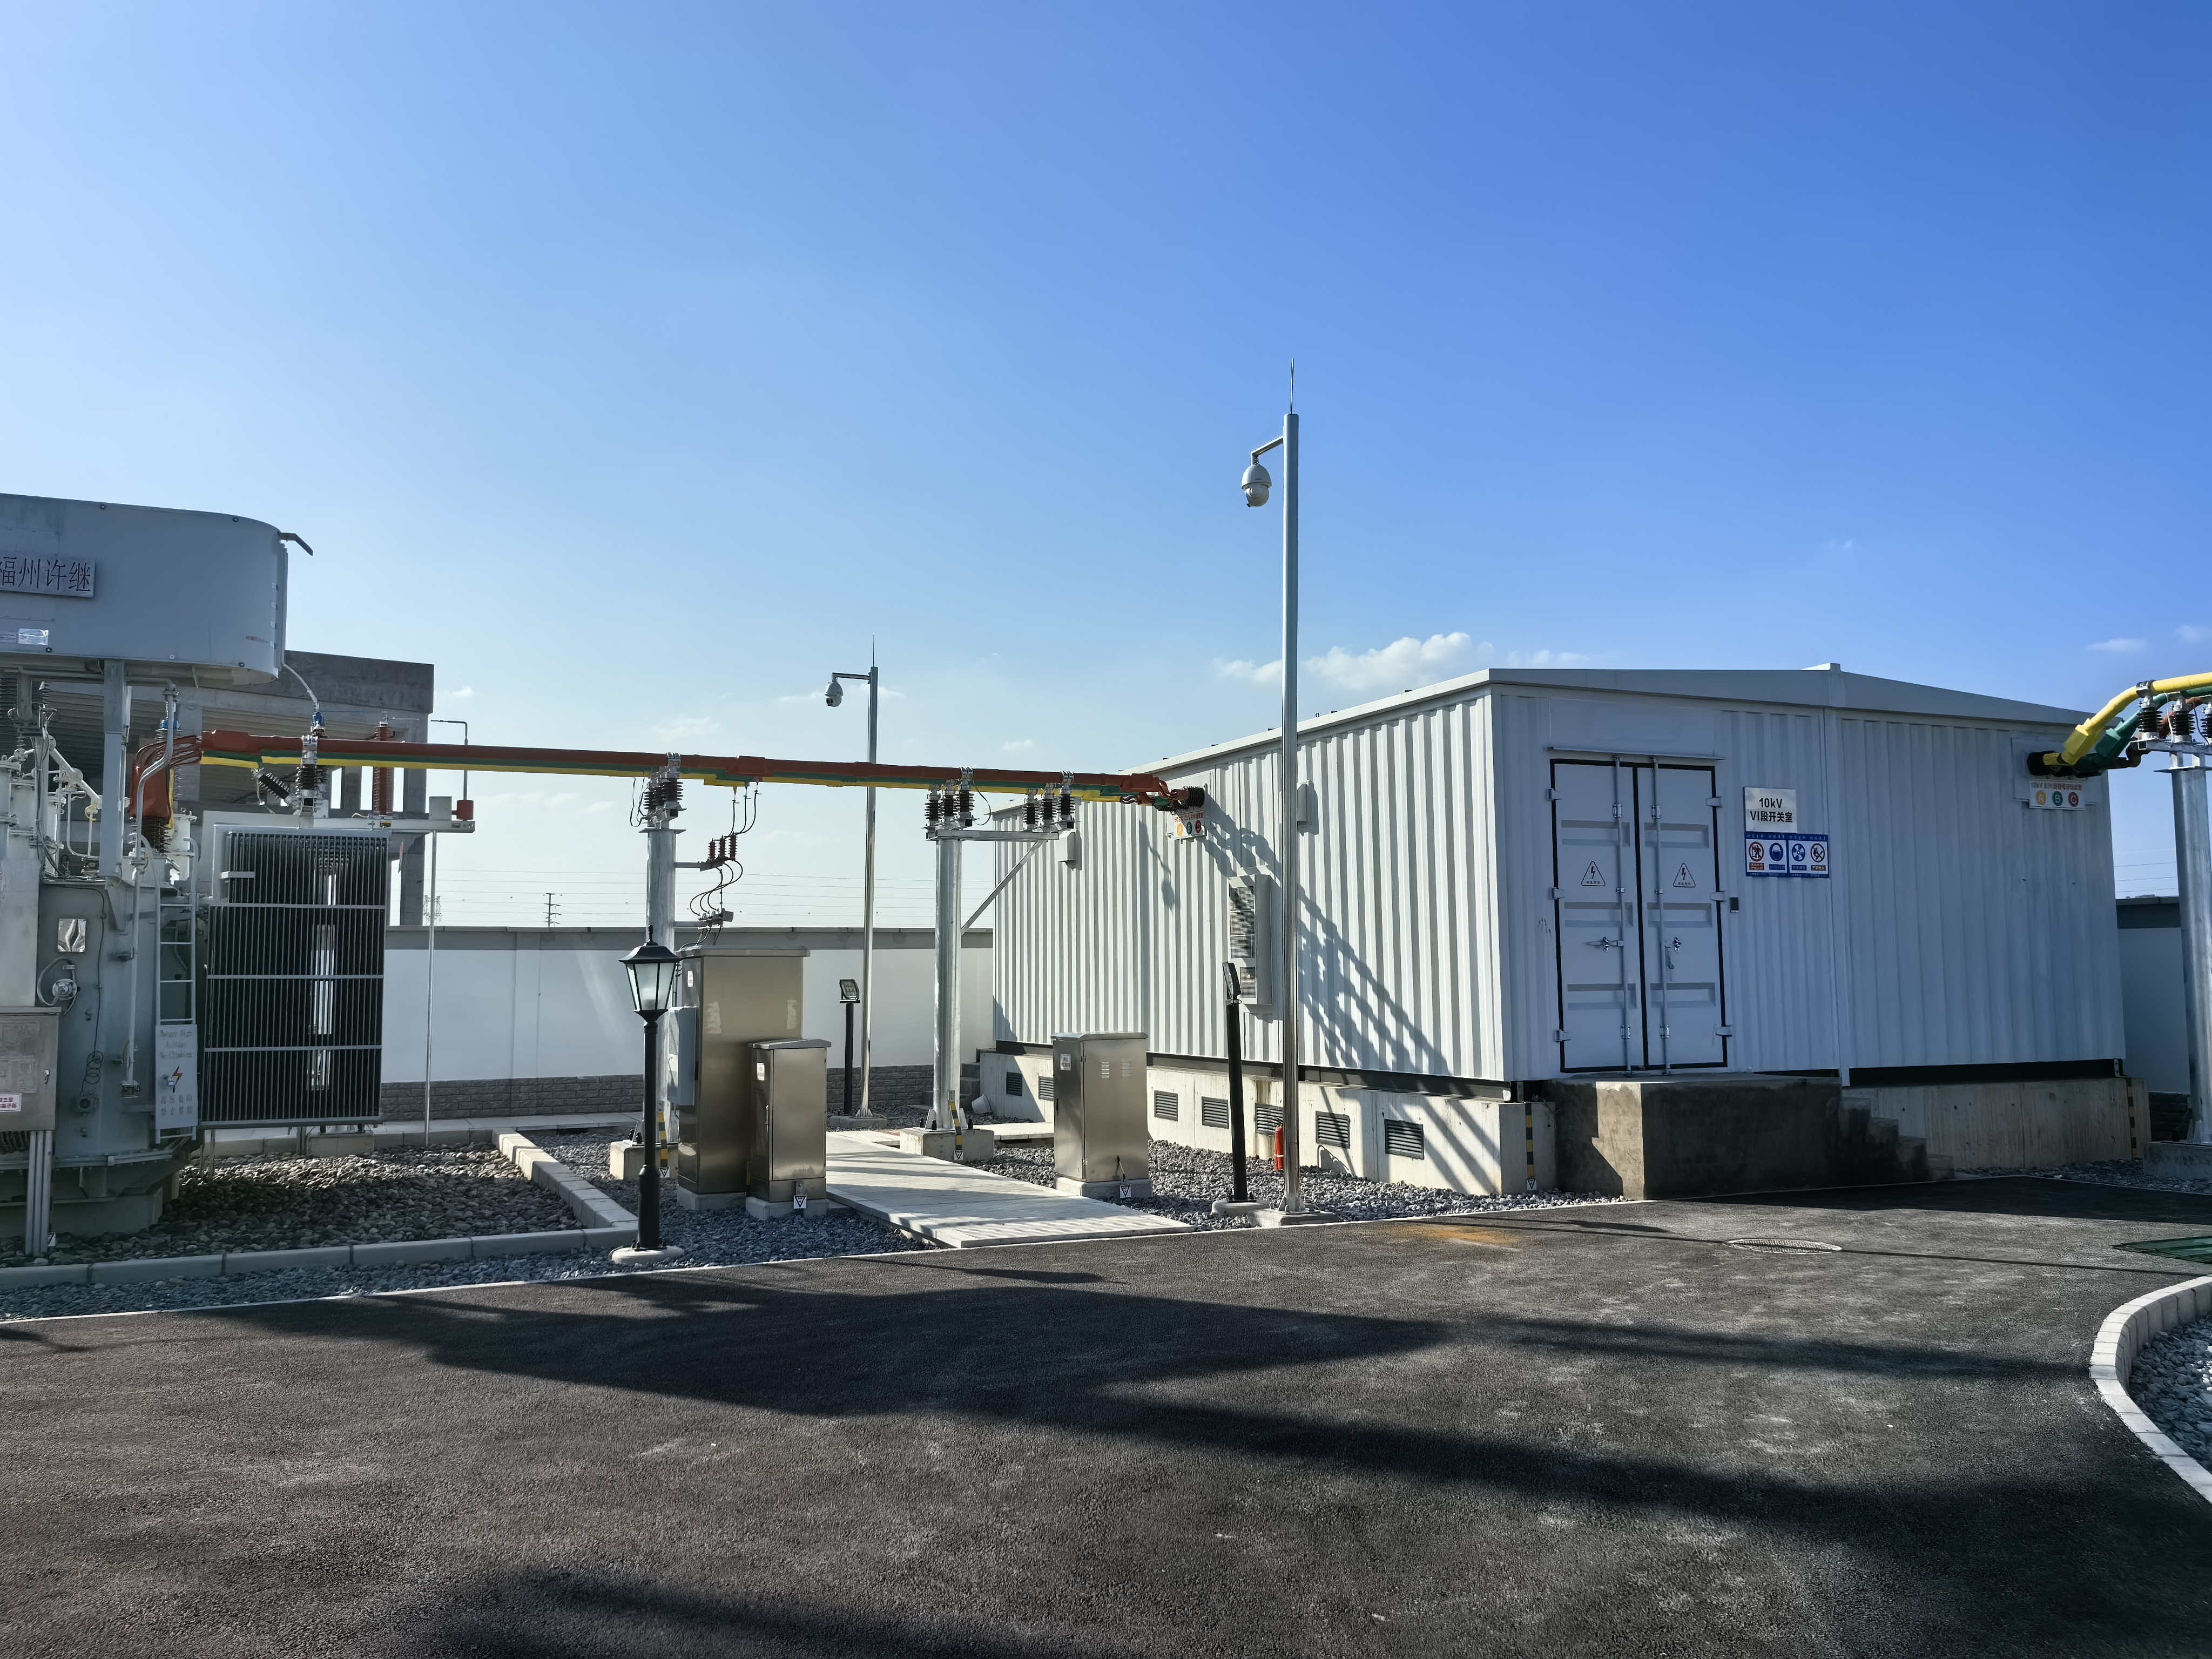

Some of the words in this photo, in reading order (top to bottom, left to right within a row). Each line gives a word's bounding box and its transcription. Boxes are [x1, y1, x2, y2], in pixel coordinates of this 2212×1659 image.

[0, 556, 91, 592] 福州许继
[1759, 798, 1783, 808] 10kV
[2038, 794, 2045, 803] A
[2055, 794, 2061, 803] B
[2071, 795, 2077, 804] C
